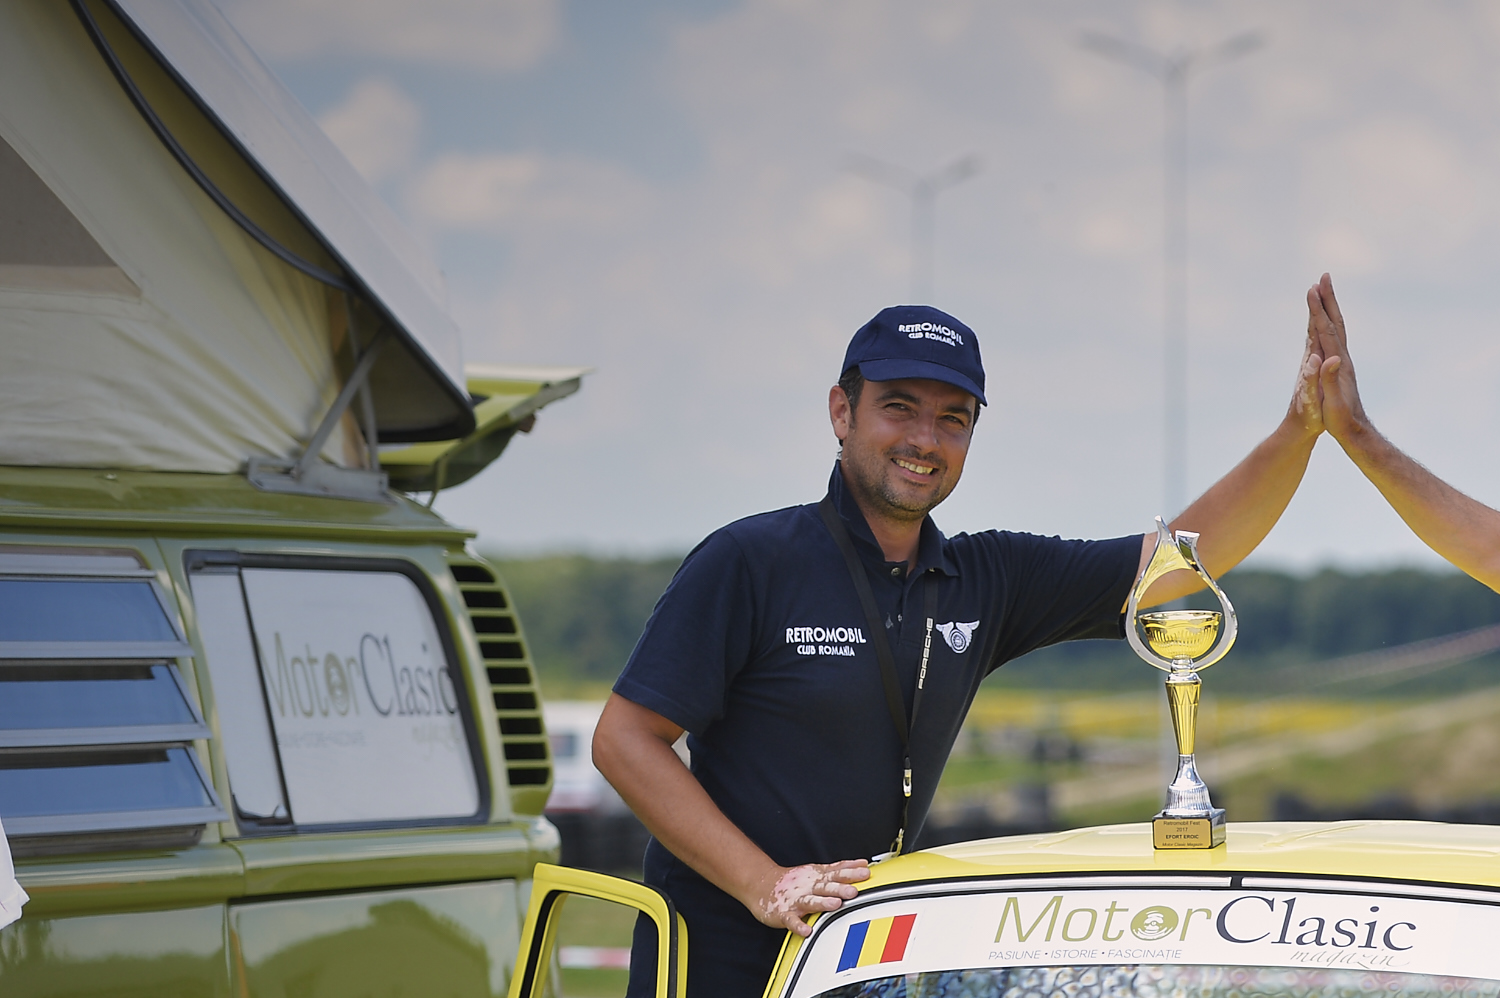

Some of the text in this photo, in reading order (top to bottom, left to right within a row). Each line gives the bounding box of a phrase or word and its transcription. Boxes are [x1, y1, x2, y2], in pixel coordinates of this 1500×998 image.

[898, 322, 964, 345] RETROMOBIL
[785, 626, 867, 644] RETROMOBIL
[797, 645, 816, 656] CLUB
[917, 617, 934, 690] PORSCHE
[988, 948, 1041, 960] PASIUNE
[1050, 948, 1098, 960] ISTORIE
[1290, 947, 1410, 970] magazin
